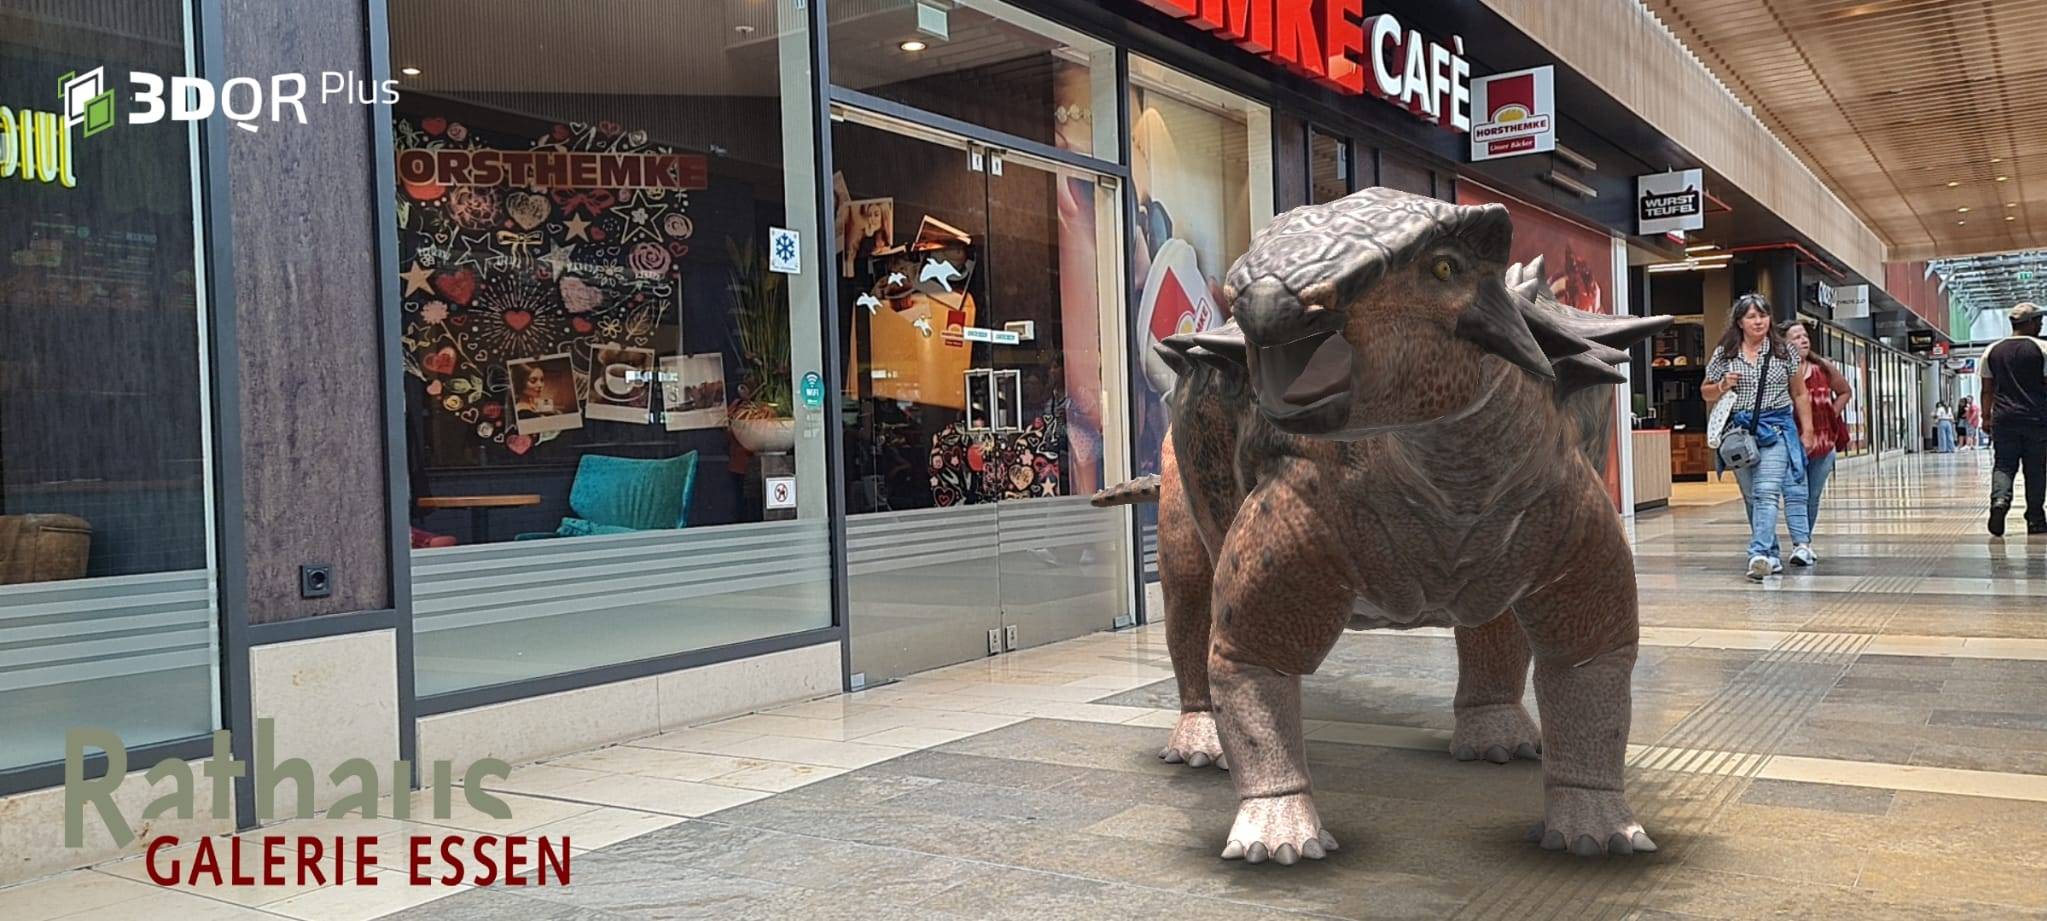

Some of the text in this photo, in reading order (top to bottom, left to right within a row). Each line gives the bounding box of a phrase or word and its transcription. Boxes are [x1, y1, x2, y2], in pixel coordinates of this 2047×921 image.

[1371, 13, 1470, 132] CAFÈ
[1476, 119, 1547, 137] HORSTHEMKE
[397, 148, 708, 189] ORSTHEMKE
[1645, 194, 1696, 207] WURST
[1645, 204, 1696, 217] TEUFEL
